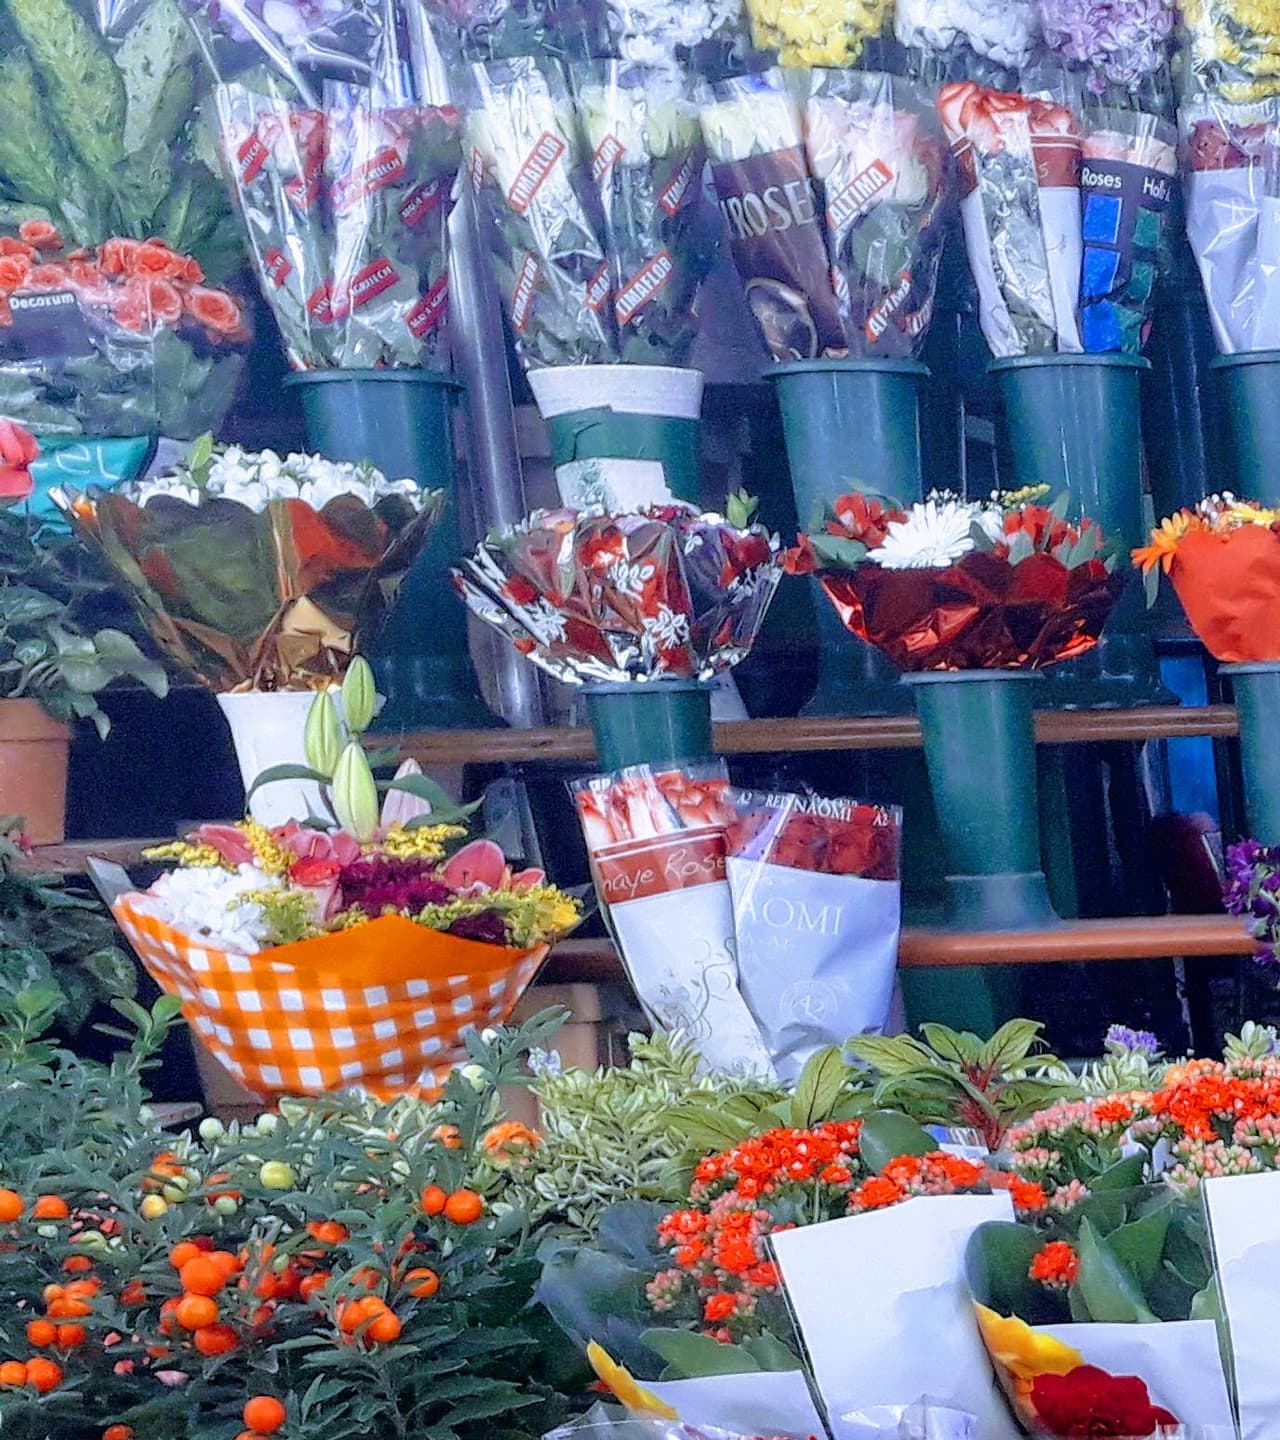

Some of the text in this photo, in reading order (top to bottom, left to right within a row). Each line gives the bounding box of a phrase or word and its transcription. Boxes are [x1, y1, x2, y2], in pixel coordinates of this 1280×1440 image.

[511, 135, 562, 207] TIMAFLOR
[829, 167, 887, 224] ALTIMA
[1082, 167, 1122, 188] Roses
[10, 293, 74, 310] Decorum
[513, 256, 538, 325] TIMAFLOR
[616, 256, 673, 316] TIMAFLOR
[793, 799, 851, 822] NAOMI
[664, 847, 725, 888] Rose
